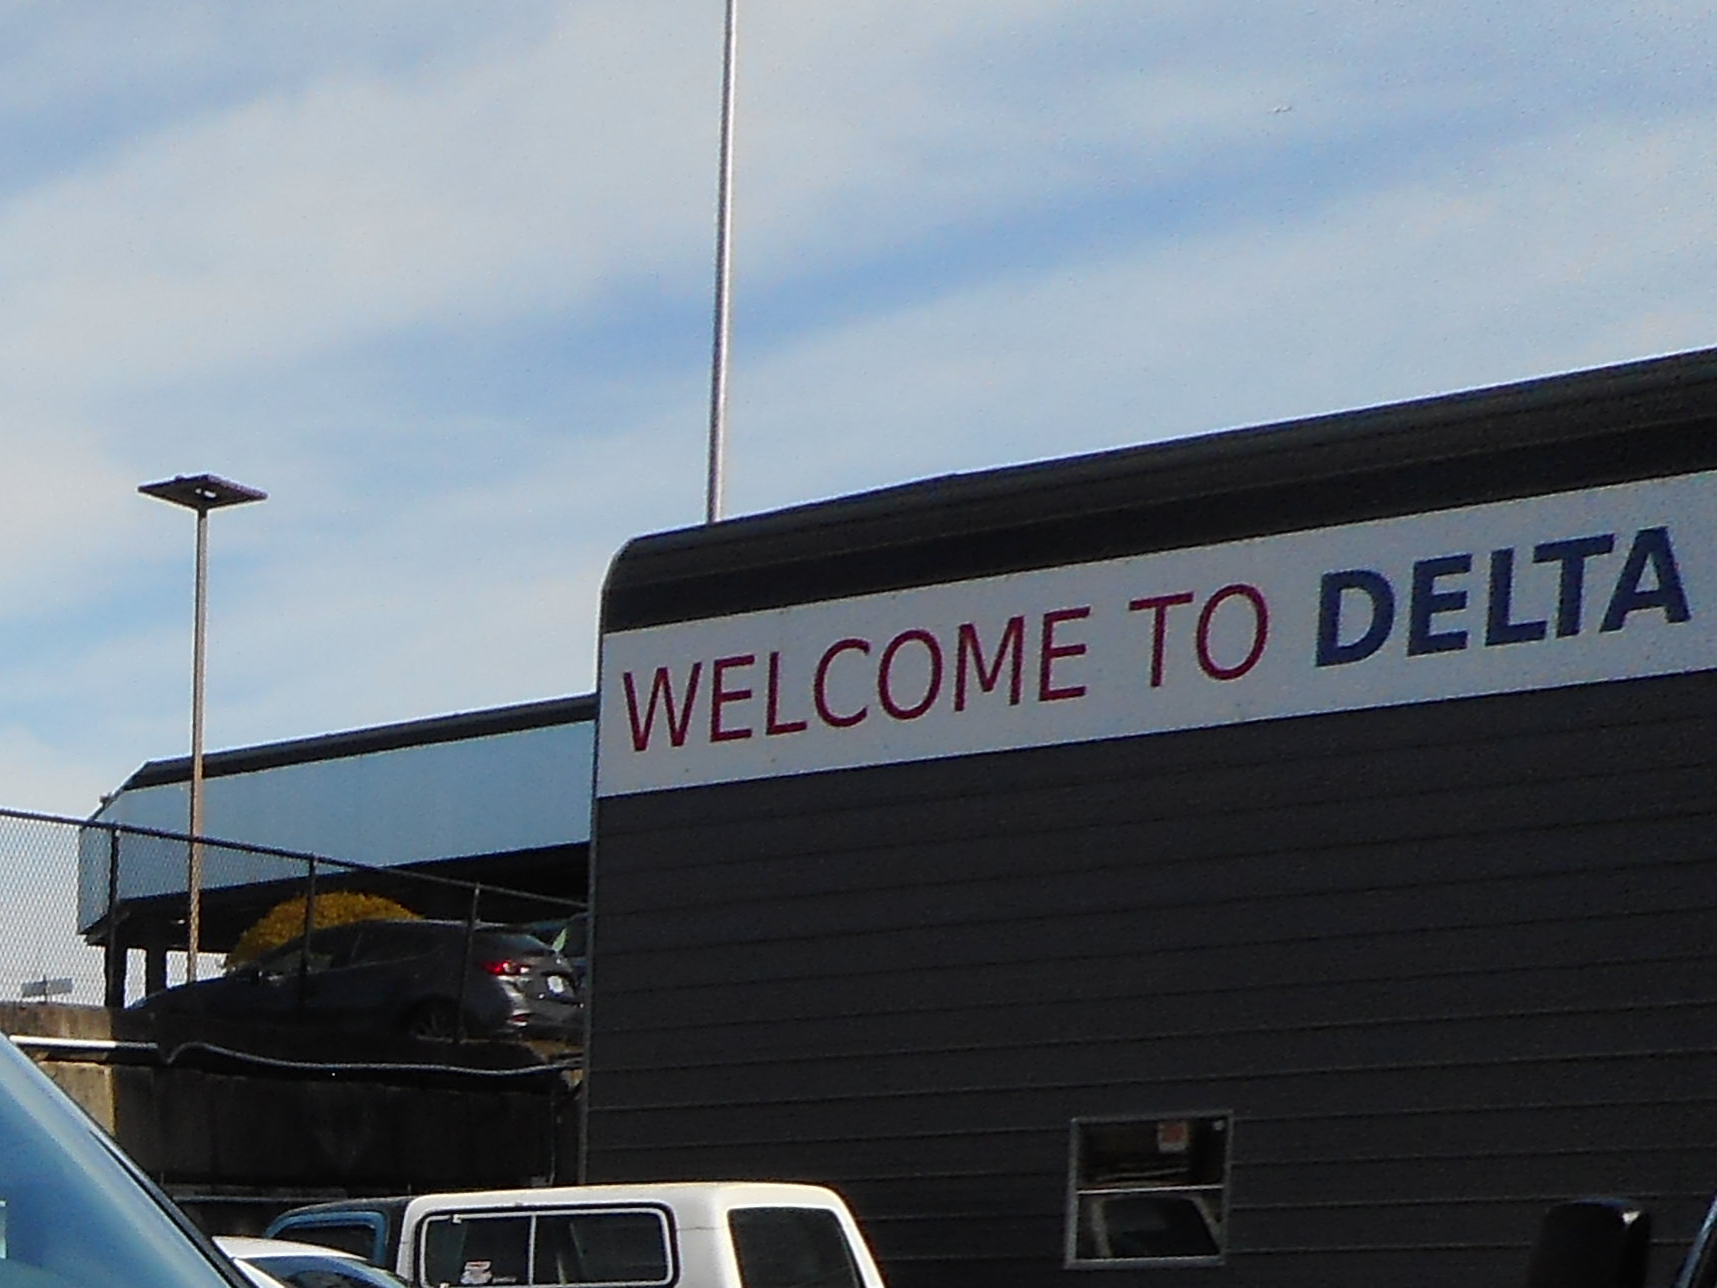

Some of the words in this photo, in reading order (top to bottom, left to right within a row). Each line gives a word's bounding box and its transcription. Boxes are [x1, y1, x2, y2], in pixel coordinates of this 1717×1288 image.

[623, 606, 1093, 752] WELCOME
[1131, 583, 1272, 686] TO
[1317, 525, 1694, 666] DELTA
